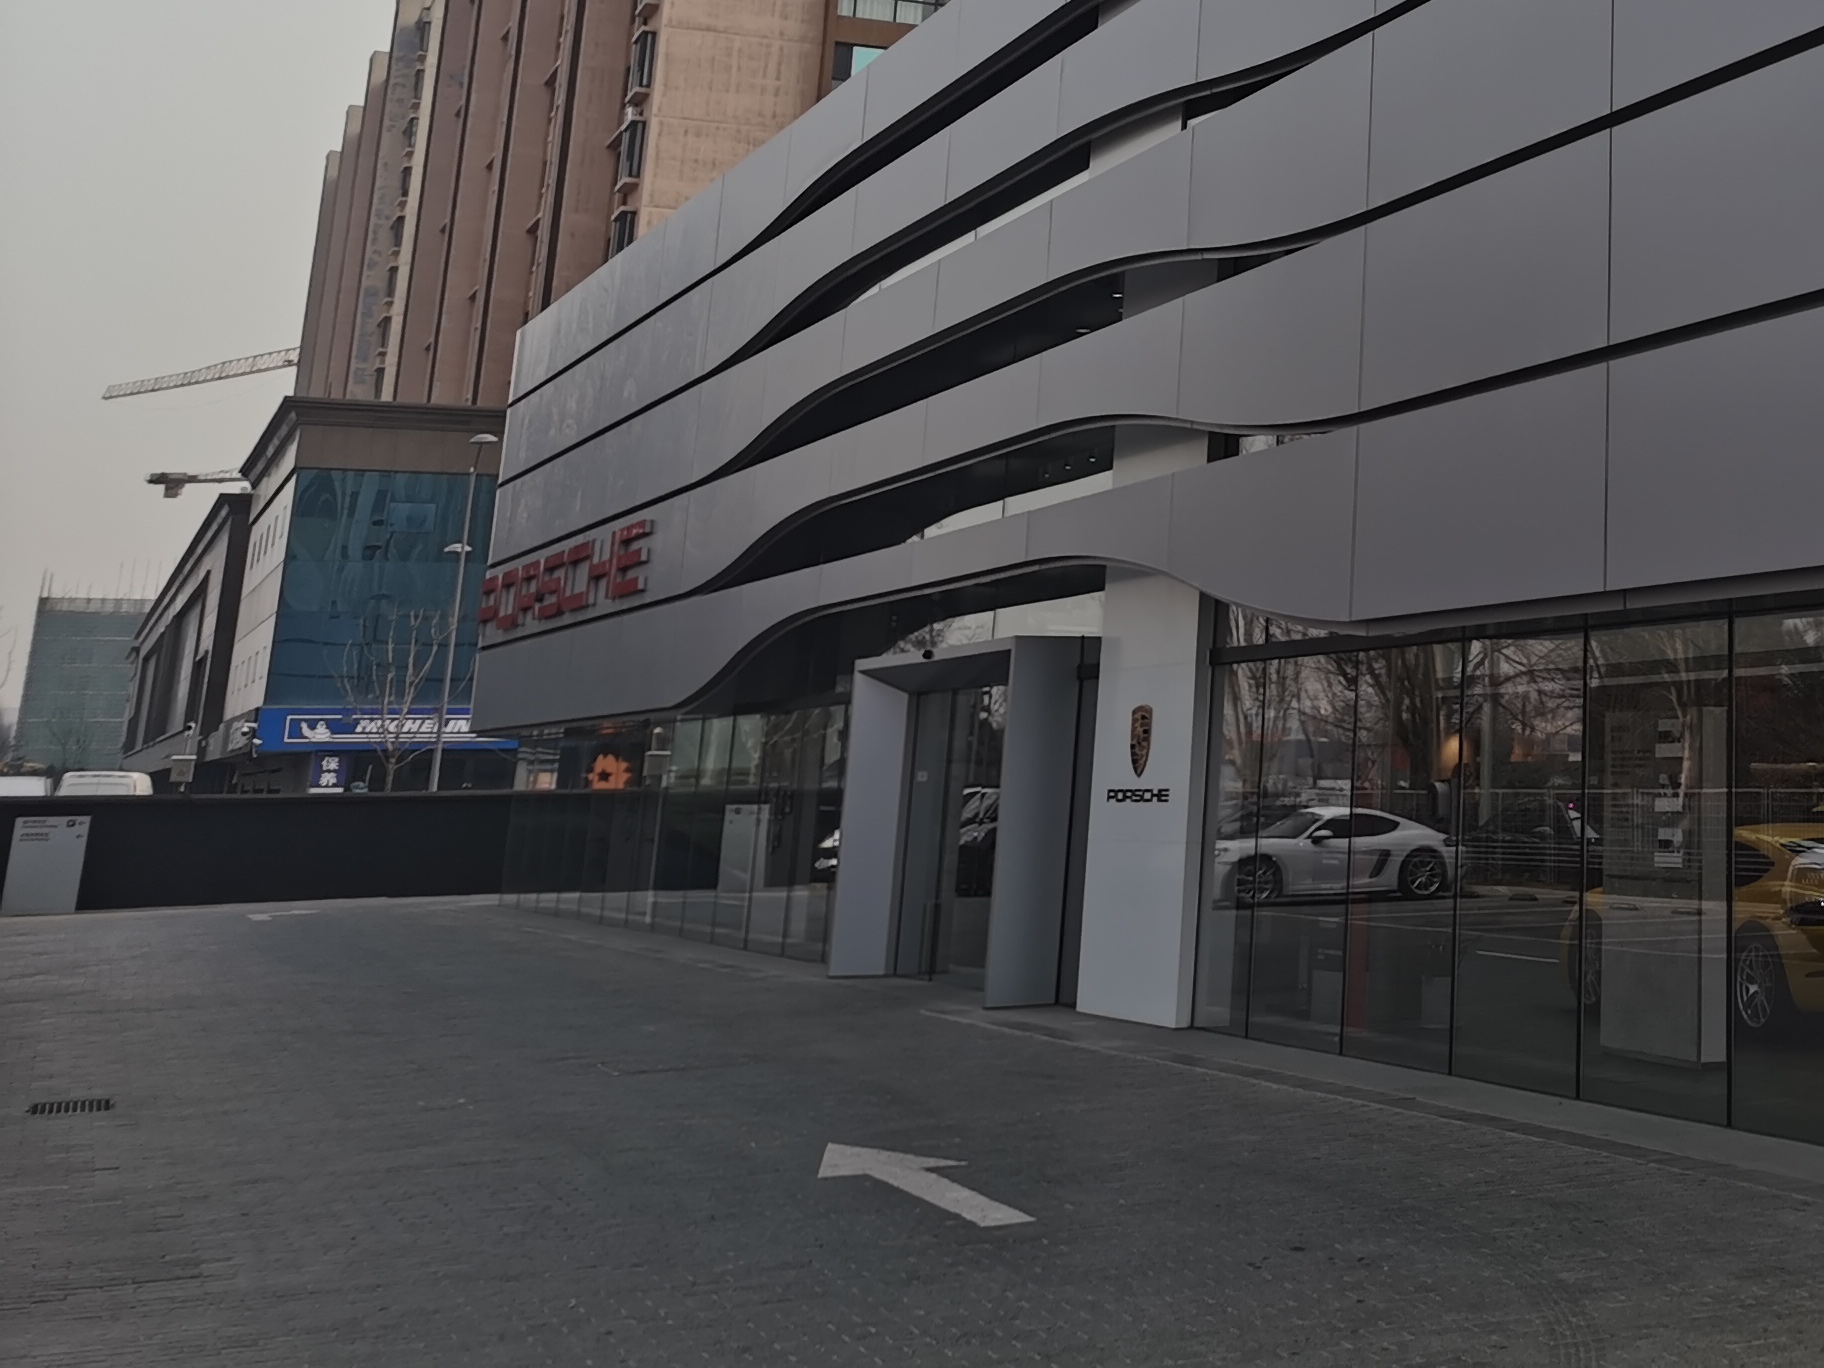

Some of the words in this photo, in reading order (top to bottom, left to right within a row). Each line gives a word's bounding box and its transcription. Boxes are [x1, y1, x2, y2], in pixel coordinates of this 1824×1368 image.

[478, 519, 654, 633] PORSCHE
[318, 756, 340, 787] 保养
[1106, 788, 1170, 803] PORSCHE
